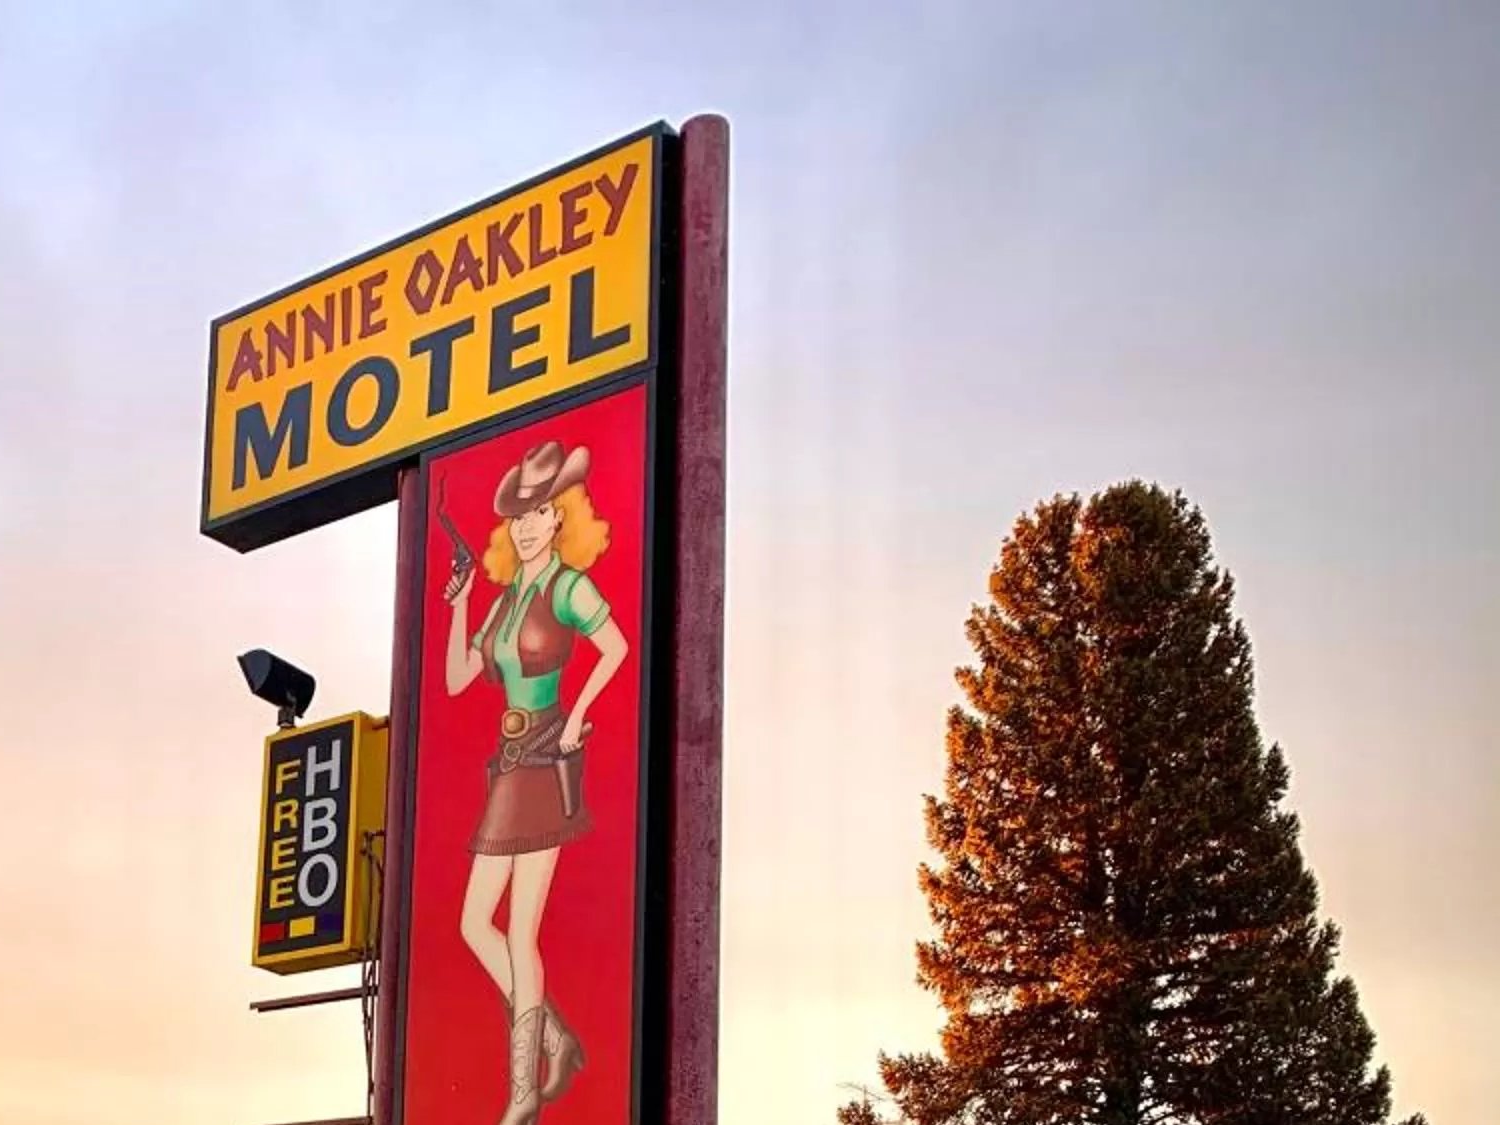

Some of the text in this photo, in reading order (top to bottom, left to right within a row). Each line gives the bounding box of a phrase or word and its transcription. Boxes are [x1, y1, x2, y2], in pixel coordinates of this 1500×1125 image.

[226, 163, 639, 392] ANNIE OAKLEY
[231, 266, 631, 491] MOTEL
[269, 759, 301, 910] FREE
[297, 739, 341, 907] HBO
